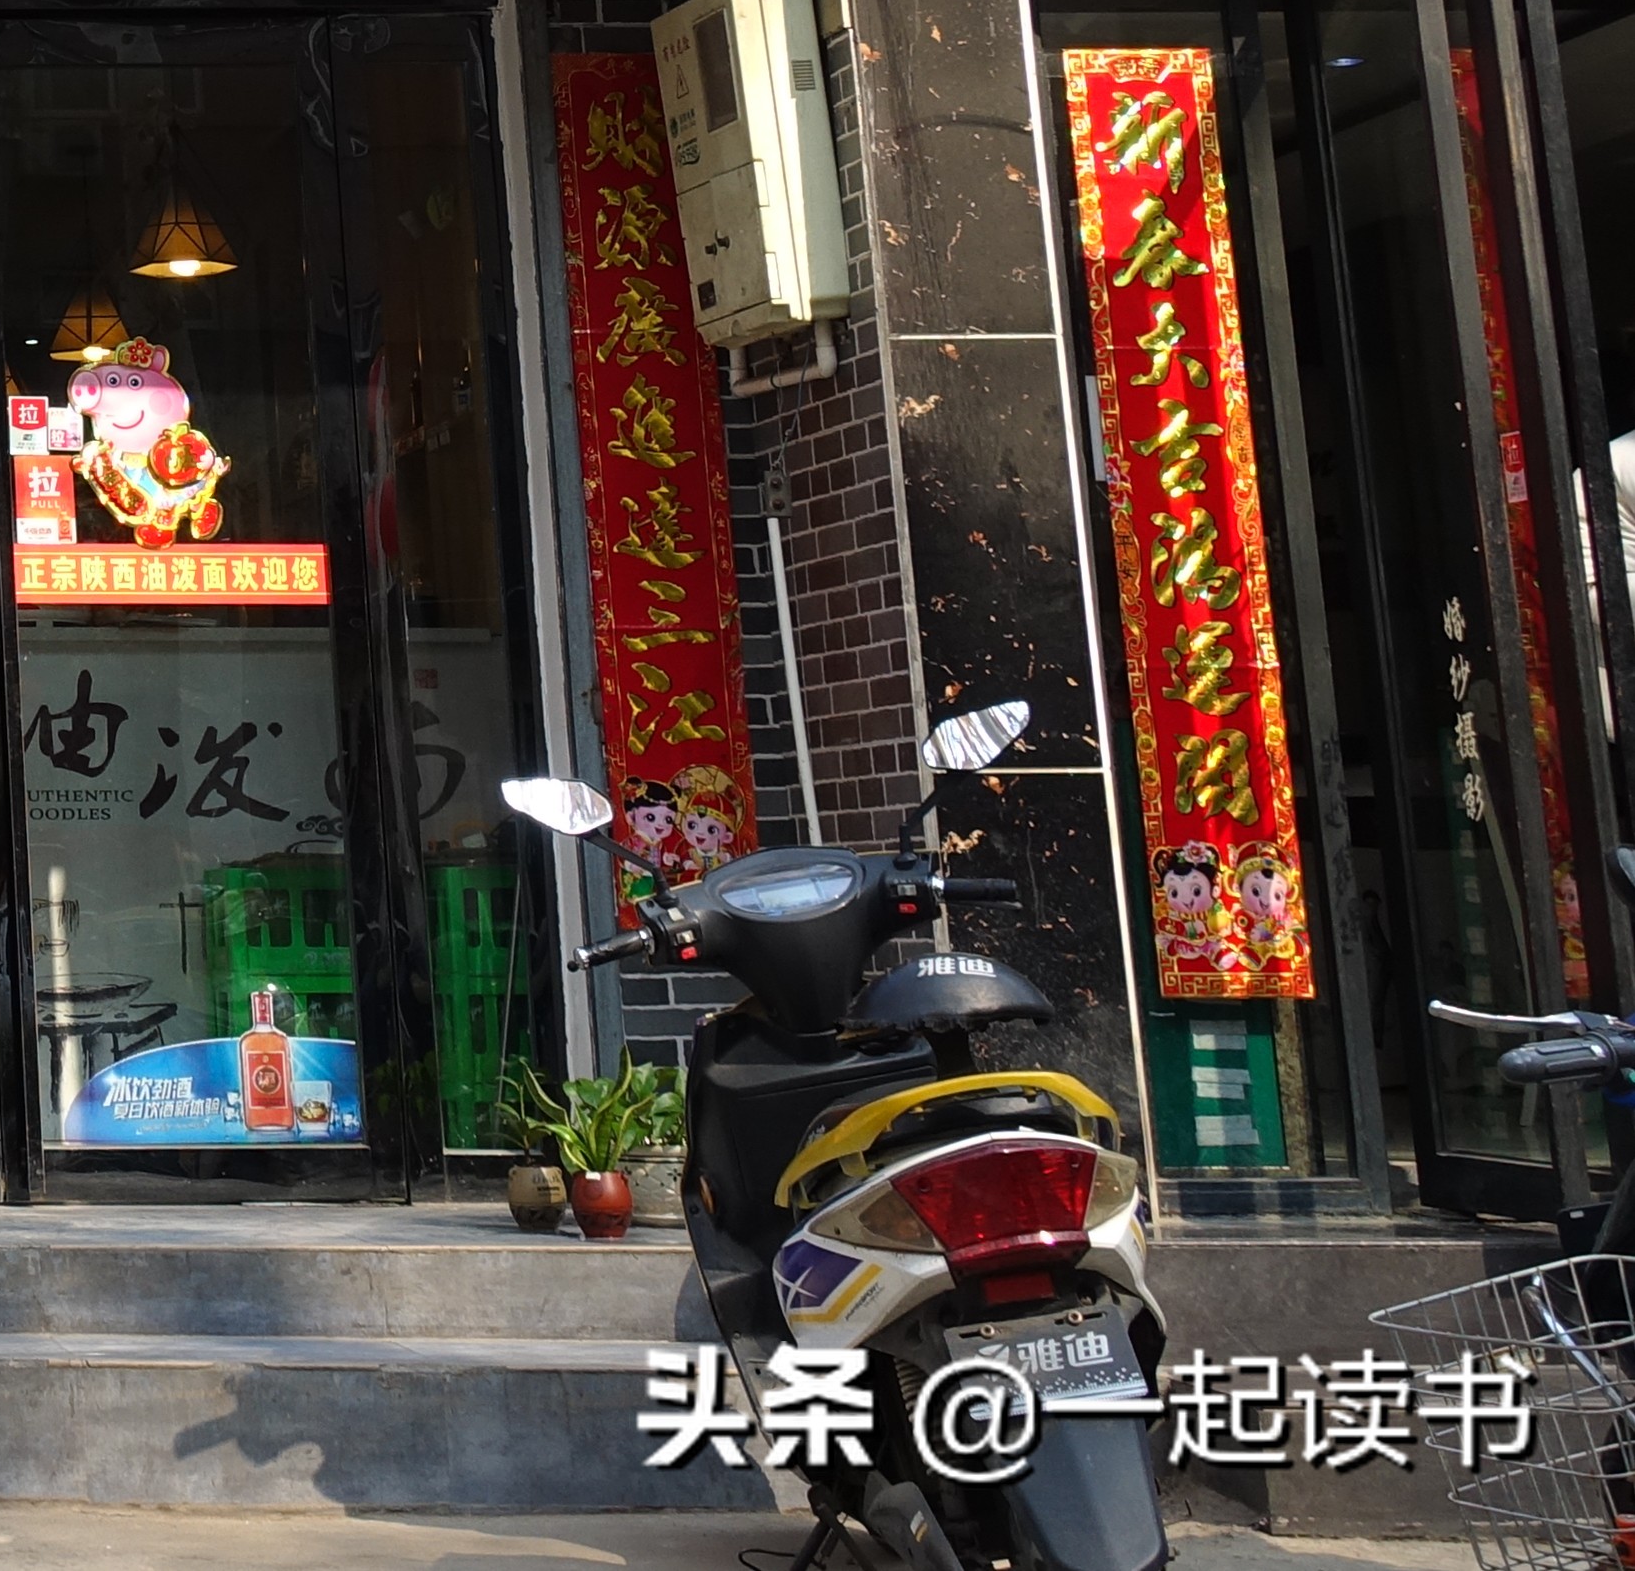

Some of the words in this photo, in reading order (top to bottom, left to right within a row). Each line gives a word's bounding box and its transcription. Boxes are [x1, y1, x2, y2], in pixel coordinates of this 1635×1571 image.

[18, 404, 40, 425] 拉
[28, 466, 61, 499] 拉
[30, 500, 61, 510] PULL
[20, 556, 319, 592] 正宗陕西油泼面欢迎您
[1442, 595, 1485, 823] 婚纱摄影
[27, 789, 134, 804] UTHENTIC
[29, 806, 112, 821] OODLES
[916, 956, 997, 978] 雅迪
[103, 1076, 193, 1106] 冰饮劲酒
[1015, 1330, 1114, 1374] 雅迪
